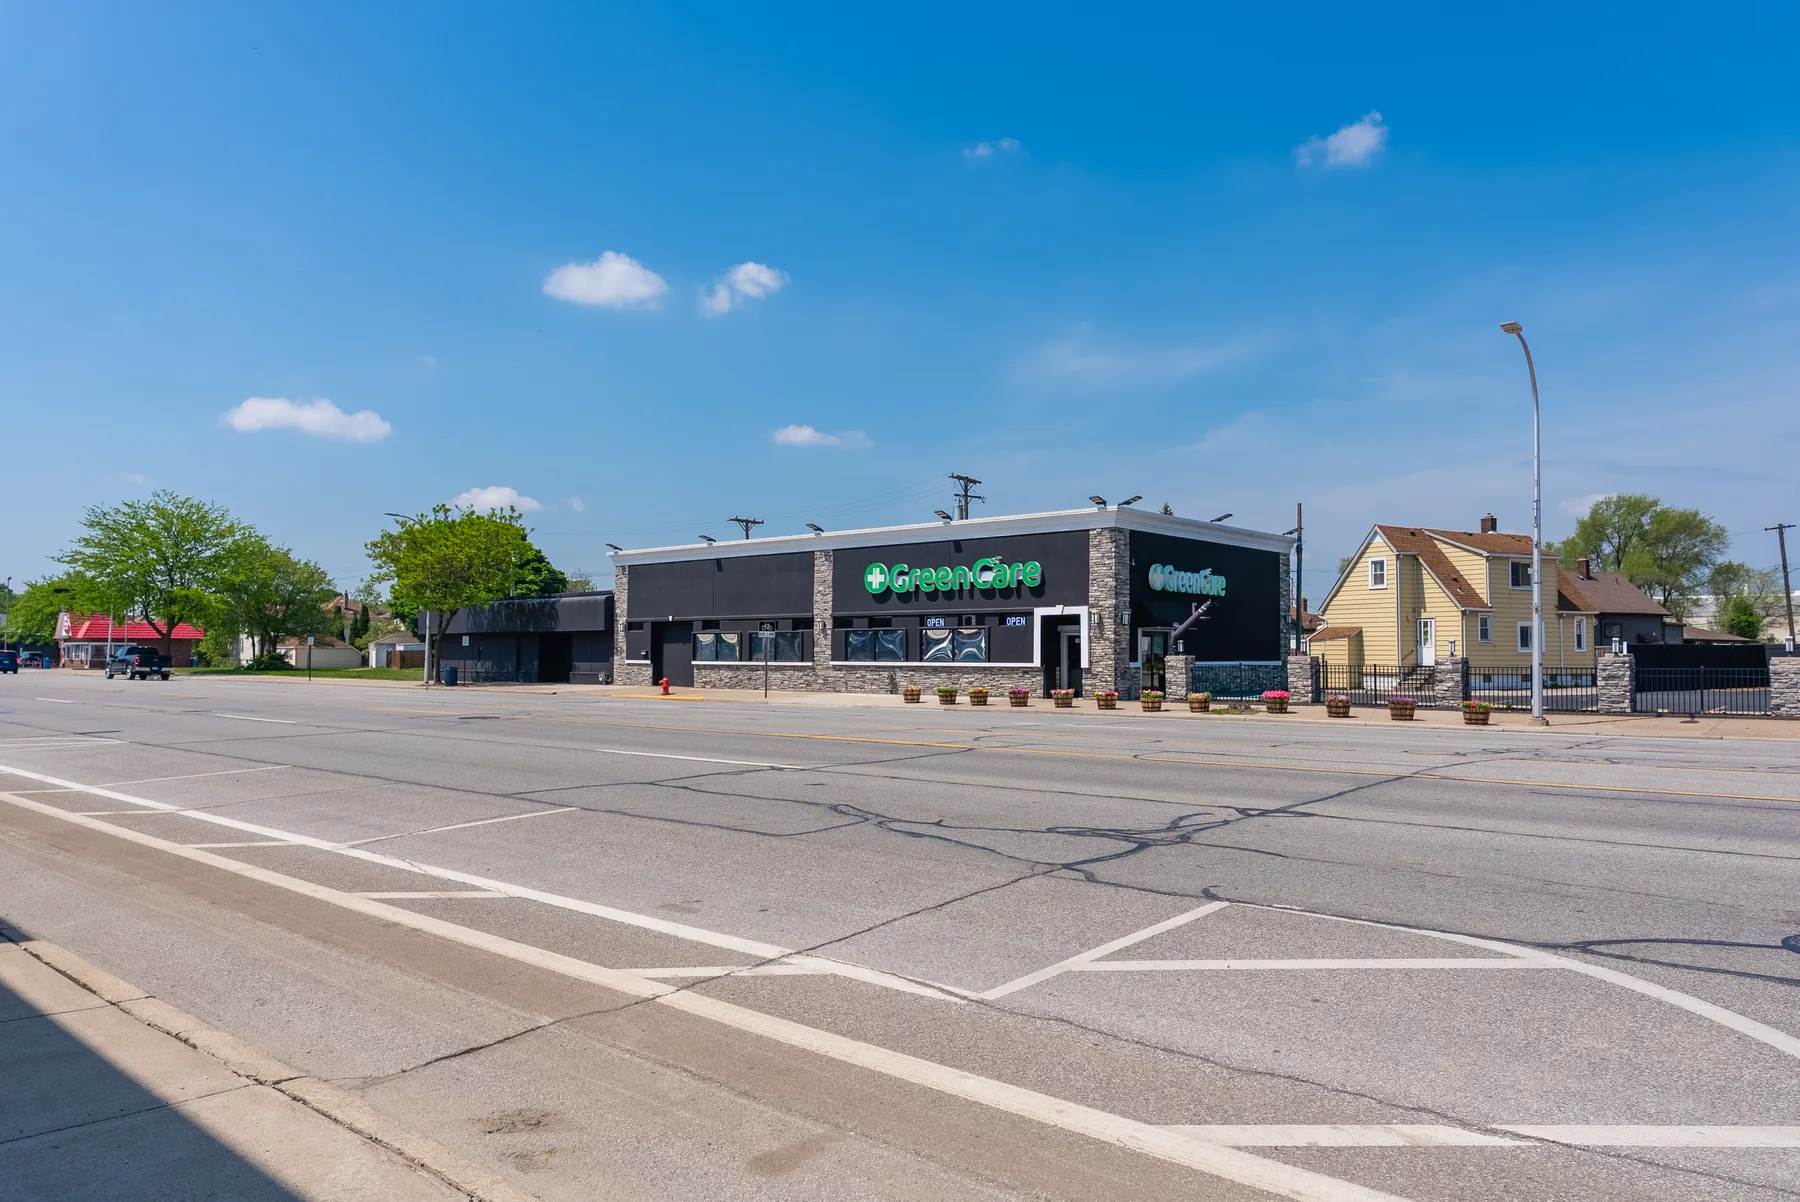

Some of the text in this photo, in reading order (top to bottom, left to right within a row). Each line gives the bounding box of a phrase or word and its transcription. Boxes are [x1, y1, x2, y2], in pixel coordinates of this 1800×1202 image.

[889, 556, 1042, 593] GreenCare
[1163, 564, 1226, 597] GreenCare
[926, 618, 945, 627] OPEN
[1006, 616, 1026, 626] OPEN
